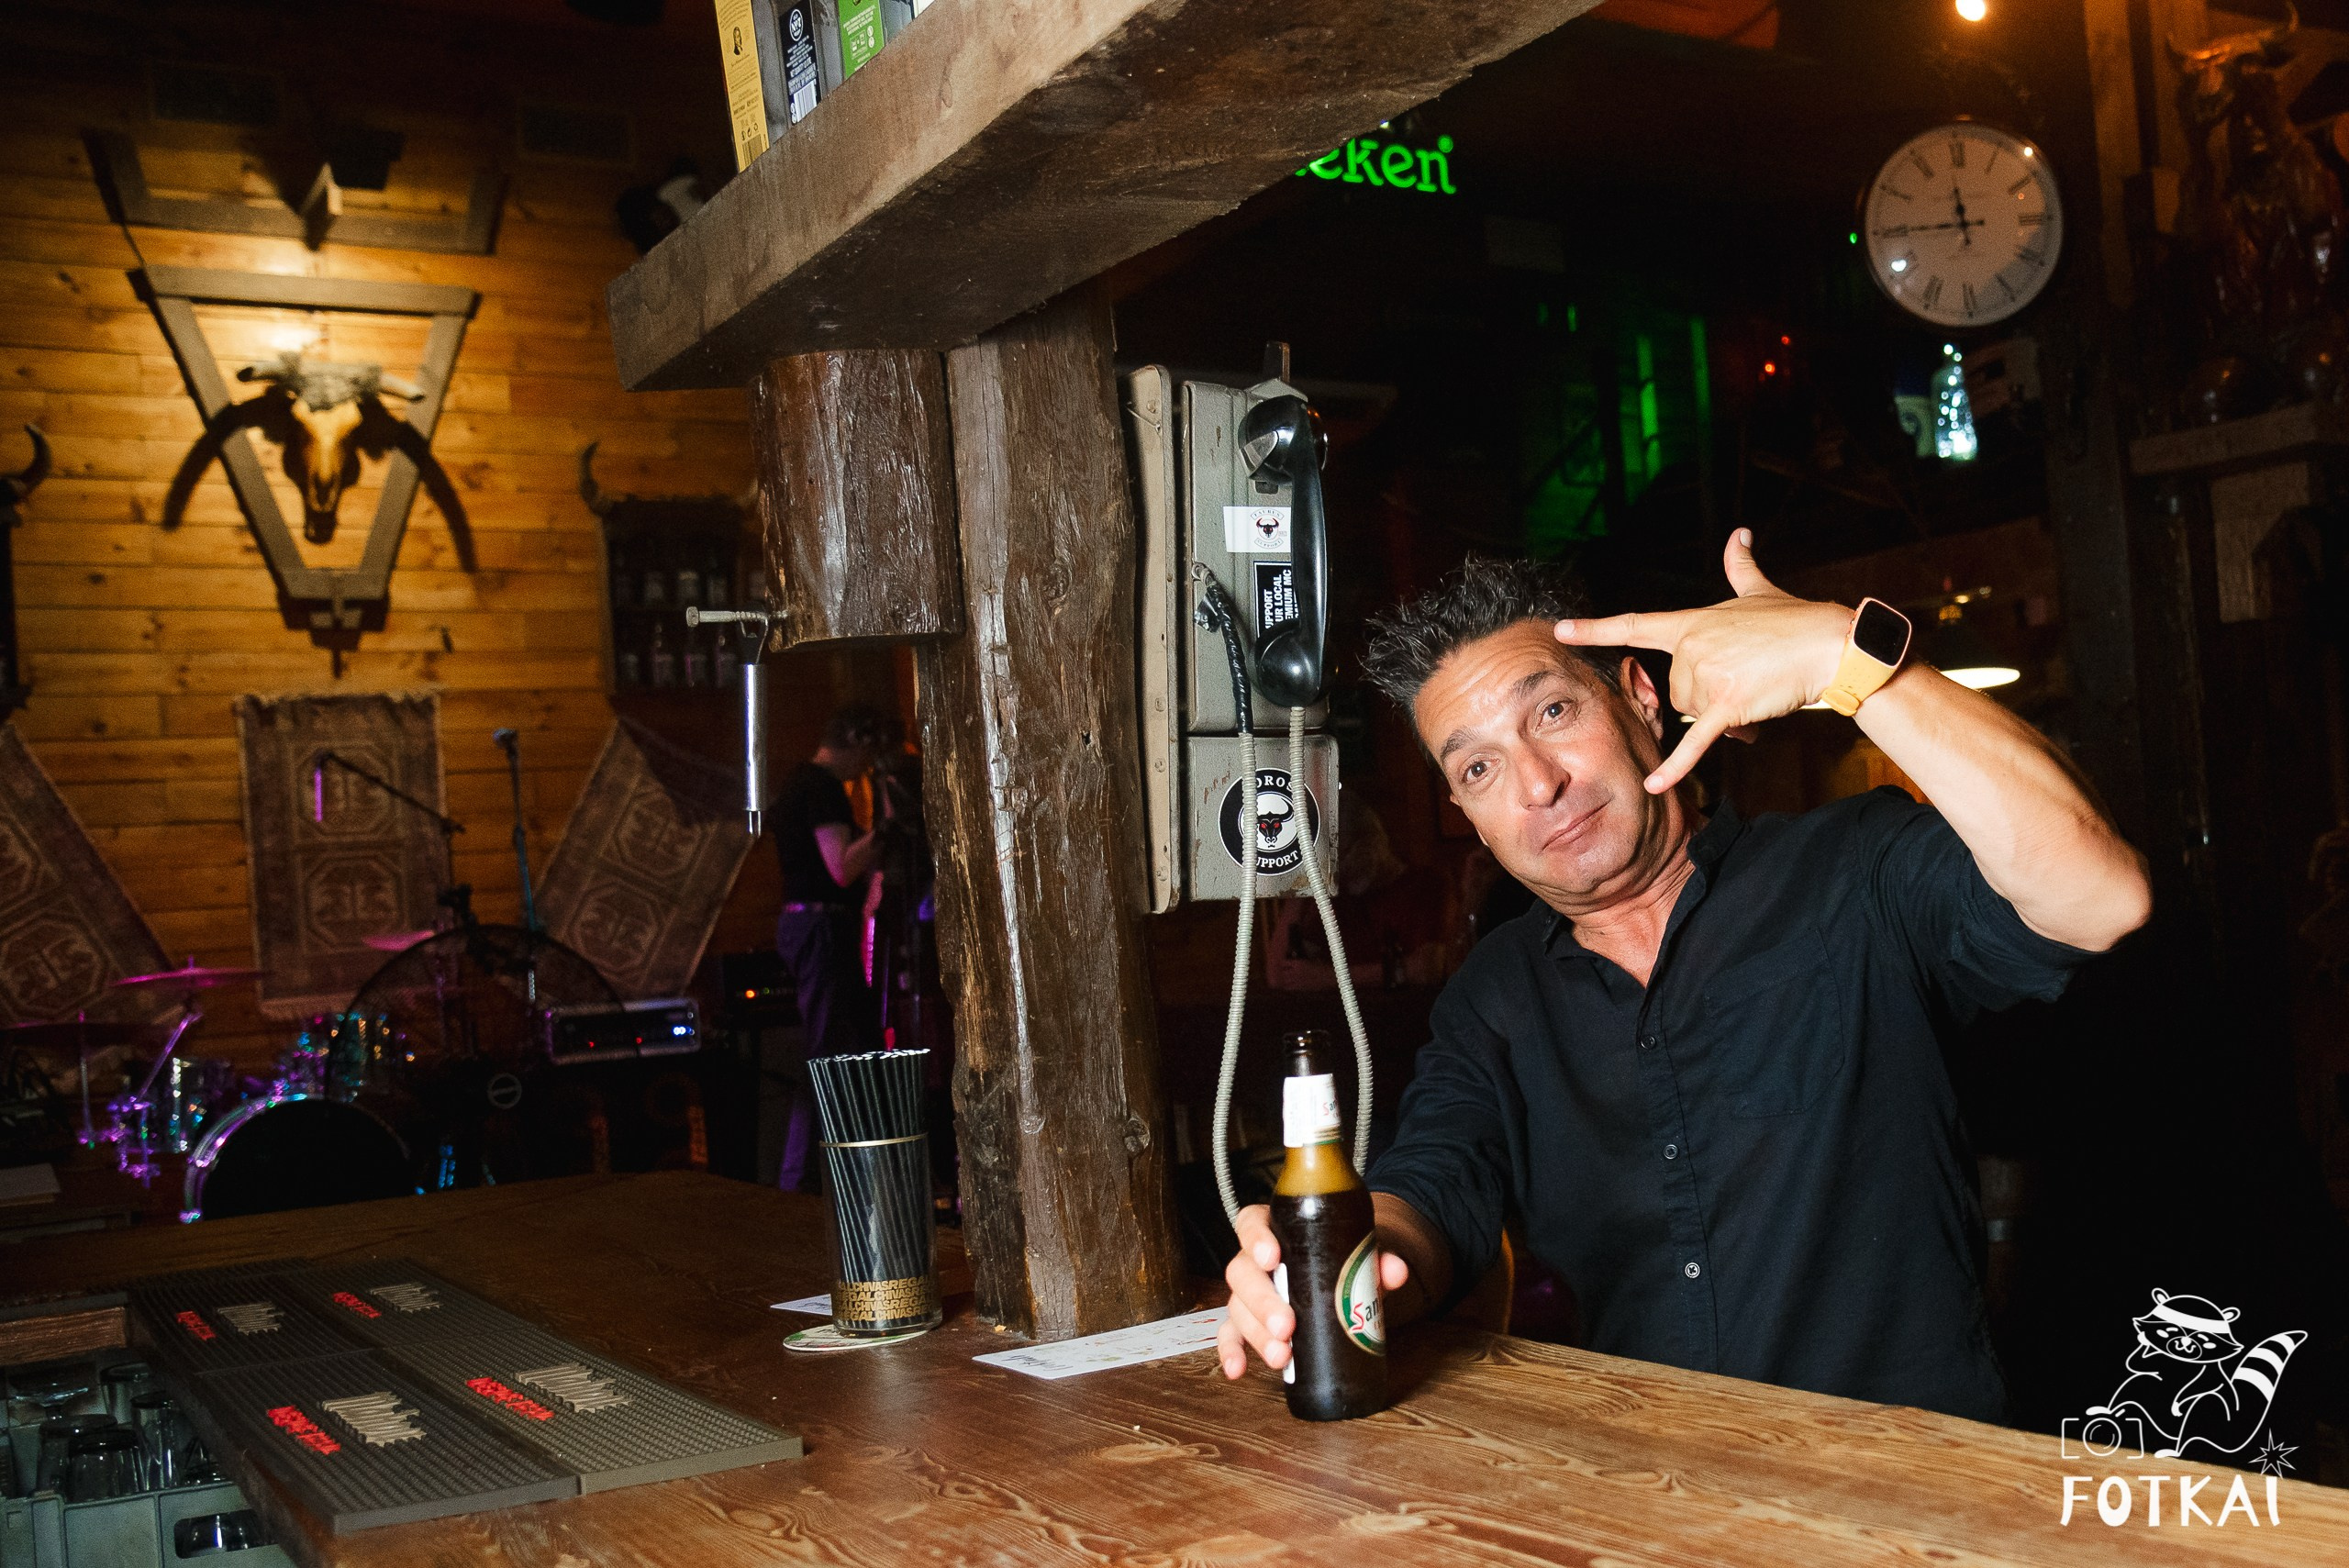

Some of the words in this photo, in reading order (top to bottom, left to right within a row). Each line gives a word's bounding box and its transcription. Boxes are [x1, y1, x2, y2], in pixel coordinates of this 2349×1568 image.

[1295, 137, 1457, 195] eken
[1273, 573, 1283, 606] LOCAL
[1283, 569, 1292, 586] MC
[1264, 588, 1275, 629] UPPORT
[1275, 607, 1284, 622] UR
